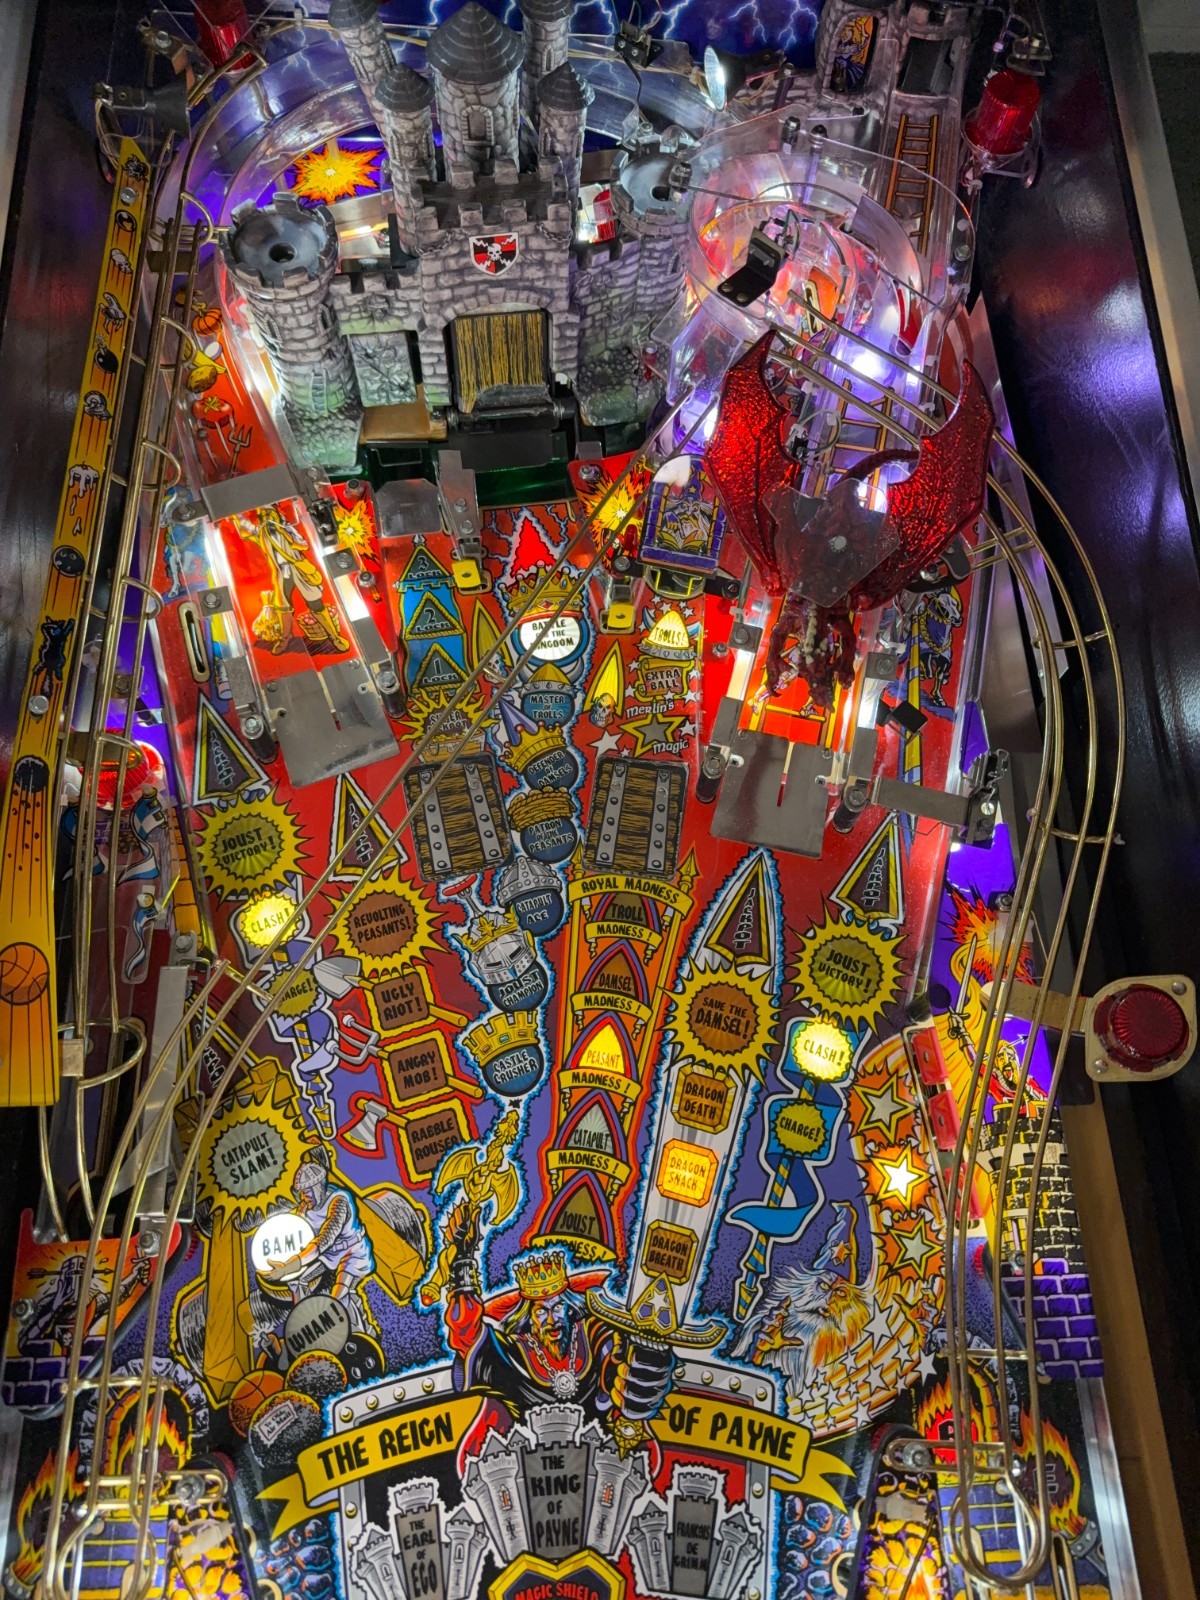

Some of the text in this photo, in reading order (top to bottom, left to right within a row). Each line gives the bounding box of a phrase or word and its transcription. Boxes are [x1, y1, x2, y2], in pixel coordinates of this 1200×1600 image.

[408, 570, 443, 579] LOCK
[418, 556, 429, 571] 3
[415, 621, 450, 632] LOCK
[424, 607, 436, 624] 2
[530, 637, 575, 650] NGDOM
[654, 627, 687, 646] TROLLS!
[423, 673, 459, 684] LOCK
[645, 668, 681, 681] EXTRA
[650, 679, 679, 691] BALL
[530, 695, 565, 705] MASTER
[533, 710, 564, 720] TROLLS
[528, 750, 566, 775] DEFENDER
[537, 763, 573, 787] DAMSELS
[528, 819, 562, 835] PATRON
[222, 827, 264, 851] JOUST
[529, 833, 575, 853] PEASANTS
[861, 848, 886, 906] JACKPOT
[581, 877, 680, 904] ROYAL MADNESS
[516, 893, 552, 912] CATAPULT
[611, 903, 644, 922] TROLL
[250, 907, 291, 934] CLASH!
[353, 903, 406, 929] REVOLTING
[526, 909, 549, 924] ACE
[732, 887, 756, 949] JACKPOT
[357, 916, 412, 944] PEASANTS!
[826, 949, 871, 976] JOUST
[381, 982, 415, 1004] UGLY
[498, 968, 540, 998] JOUST
[599, 972, 632, 992] DAMSEL
[502, 979, 544, 1008] CHAMPION
[729, 1003, 748, 1018] THE
[694, 1007, 751, 1039] DAMSEL!
[397, 1051, 436, 1074] ANGRY
[493, 1049, 529, 1073] CASTLE
[586, 1049, 621, 1069] PEASANT
[803, 1039, 844, 1066] CLASH!
[493, 1057, 540, 1086] CRUSHER
[685, 1082, 725, 1104] DRAGON
[684, 1100, 717, 1120] DEATH
[411, 1118, 456, 1144] RABBLE
[573, 1129, 610, 1150] CATAPULT
[779, 1116, 821, 1142] CHARGE!
[220, 1132, 270, 1168] CATAPULT
[230, 1147, 279, 1184] SLAM!
[669, 1157, 706, 1178] DRAGON
[668, 1173, 698, 1191] SNACK
[560, 1210, 596, 1235] JOUST
[262, 1230, 305, 1257] BAM!
[651, 1235, 689, 1257] DRAGON
[649, 1250, 684, 1271] BREATH
[287, 1302, 345, 1353] WHAM!
[669, 1403, 797, 1462] OF PAYNE
[317, 1411, 454, 1480] THE REIGN
[540, 1455, 565, 1471] THE
[530, 1474, 582, 1497] KING
[547, 1500, 563, 1515] OF
[409, 1519, 425, 1532] THE
[535, 1517, 579, 1548] PAYNE
[403, 1530, 436, 1550] EARL
[416, 1549, 426, 1560] OF
[411, 1559, 438, 1598] EGO
[515, 1583, 553, 1600] MAGIC
